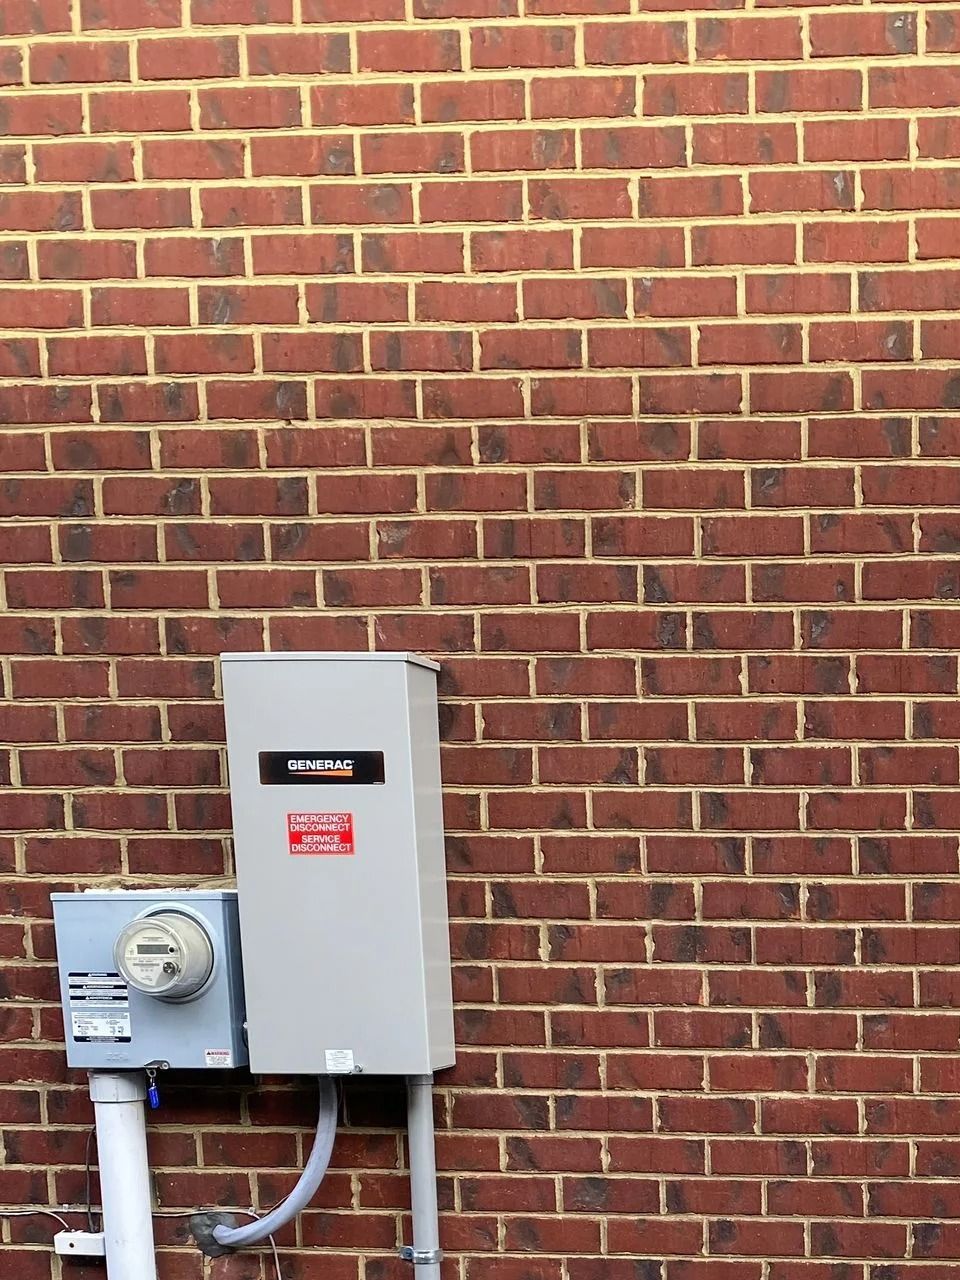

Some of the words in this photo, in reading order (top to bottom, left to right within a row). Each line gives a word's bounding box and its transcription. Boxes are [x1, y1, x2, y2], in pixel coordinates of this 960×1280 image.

[287, 760, 353, 770] GENERAC
[290, 815, 349, 823] EMERGENCY
[290, 823, 350, 832] DISCONNECT
[301, 834, 340, 843] SERVICE
[291, 843, 351, 852] DISCONNECT
